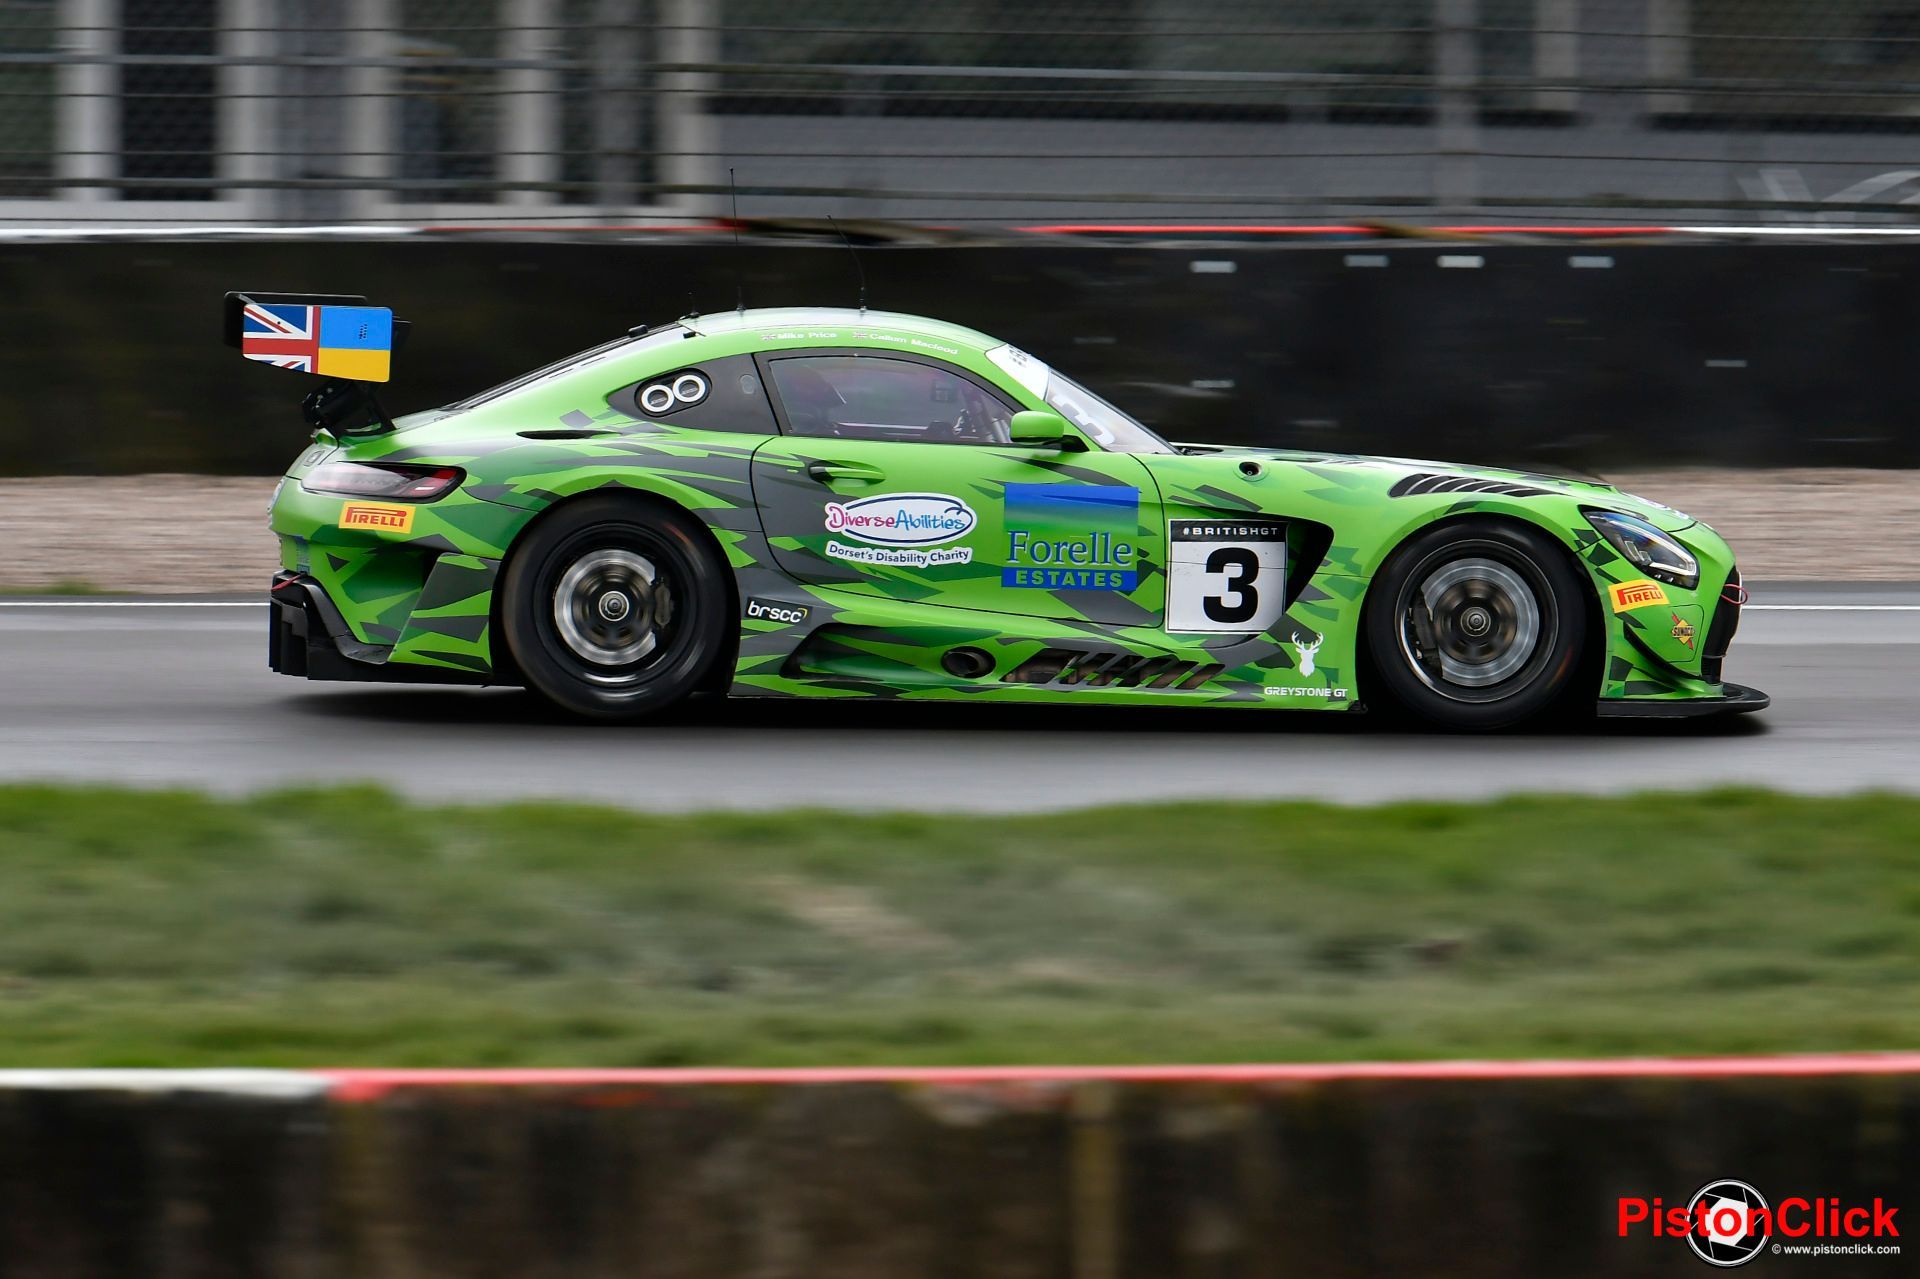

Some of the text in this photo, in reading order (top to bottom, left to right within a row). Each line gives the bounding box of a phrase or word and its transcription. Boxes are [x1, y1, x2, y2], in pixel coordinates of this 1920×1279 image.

[345, 506, 407, 528] PIRELLI
[829, 506, 966, 530] DiverseAbilities
[1183, 526, 1279, 536] #BRITISHGT
[829, 543, 969, 565] Dorset's Disability Charity
[1007, 530, 1133, 565] Forelle
[1016, 569, 1123, 588] ESTATES
[1203, 547, 1260, 624] 3
[1616, 584, 1664, 606] PIRELLI
[747, 600, 802, 623] brscc
[1264, 686, 1349, 698] GREYSTONE GT
